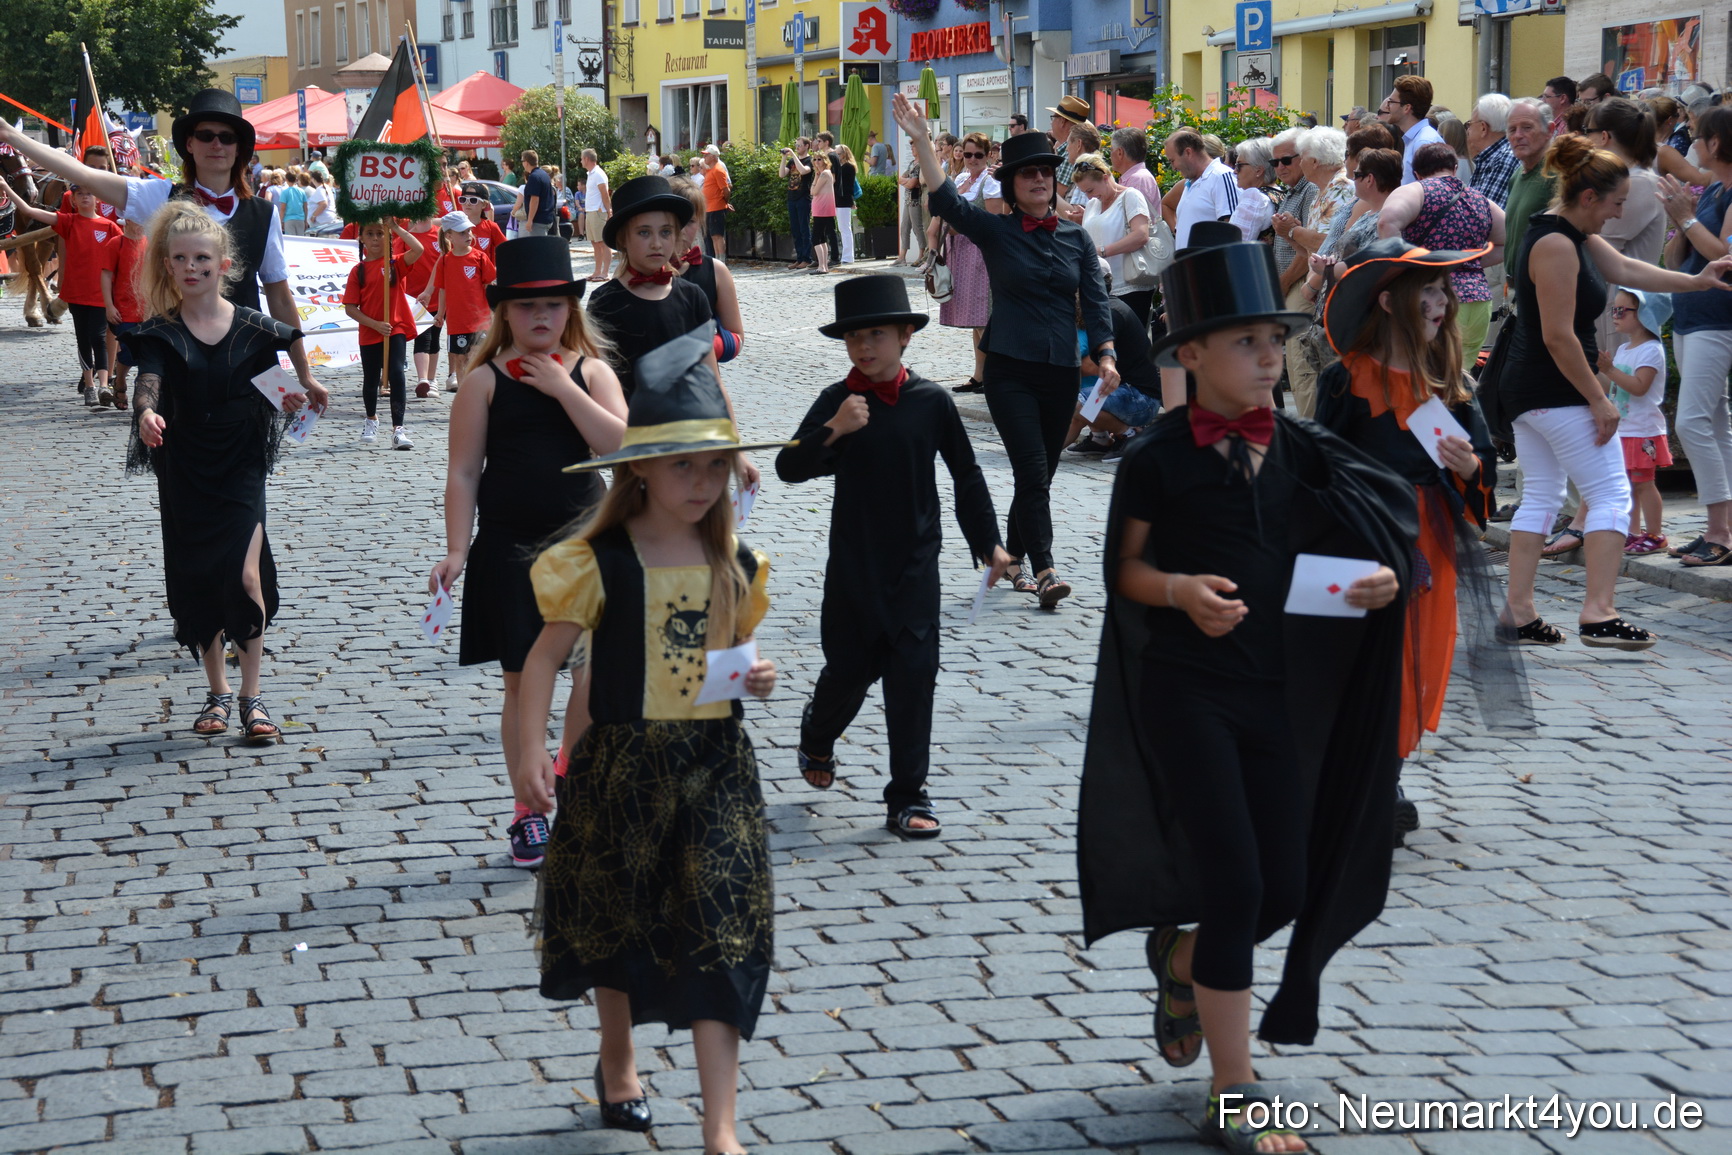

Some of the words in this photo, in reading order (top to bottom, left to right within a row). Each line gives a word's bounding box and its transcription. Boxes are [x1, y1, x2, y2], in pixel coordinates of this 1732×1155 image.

[780, 21, 811, 42] TAIN
[796, 18, 802, 49] P
[1244, 7, 1264, 46] P
[706, 37, 744, 46] TAIFUN
[908, 22, 994, 62] APOTHEKE
[665, 52, 708, 73] Restaurant
[967, 77, 985, 88] RATHAUS
[986, 74, 1008, 87] APOTHEKE
[360, 155, 416, 180] BSC
[350, 184, 426, 204] Woffenbach
[296, 272, 348, 280] Bayeris
